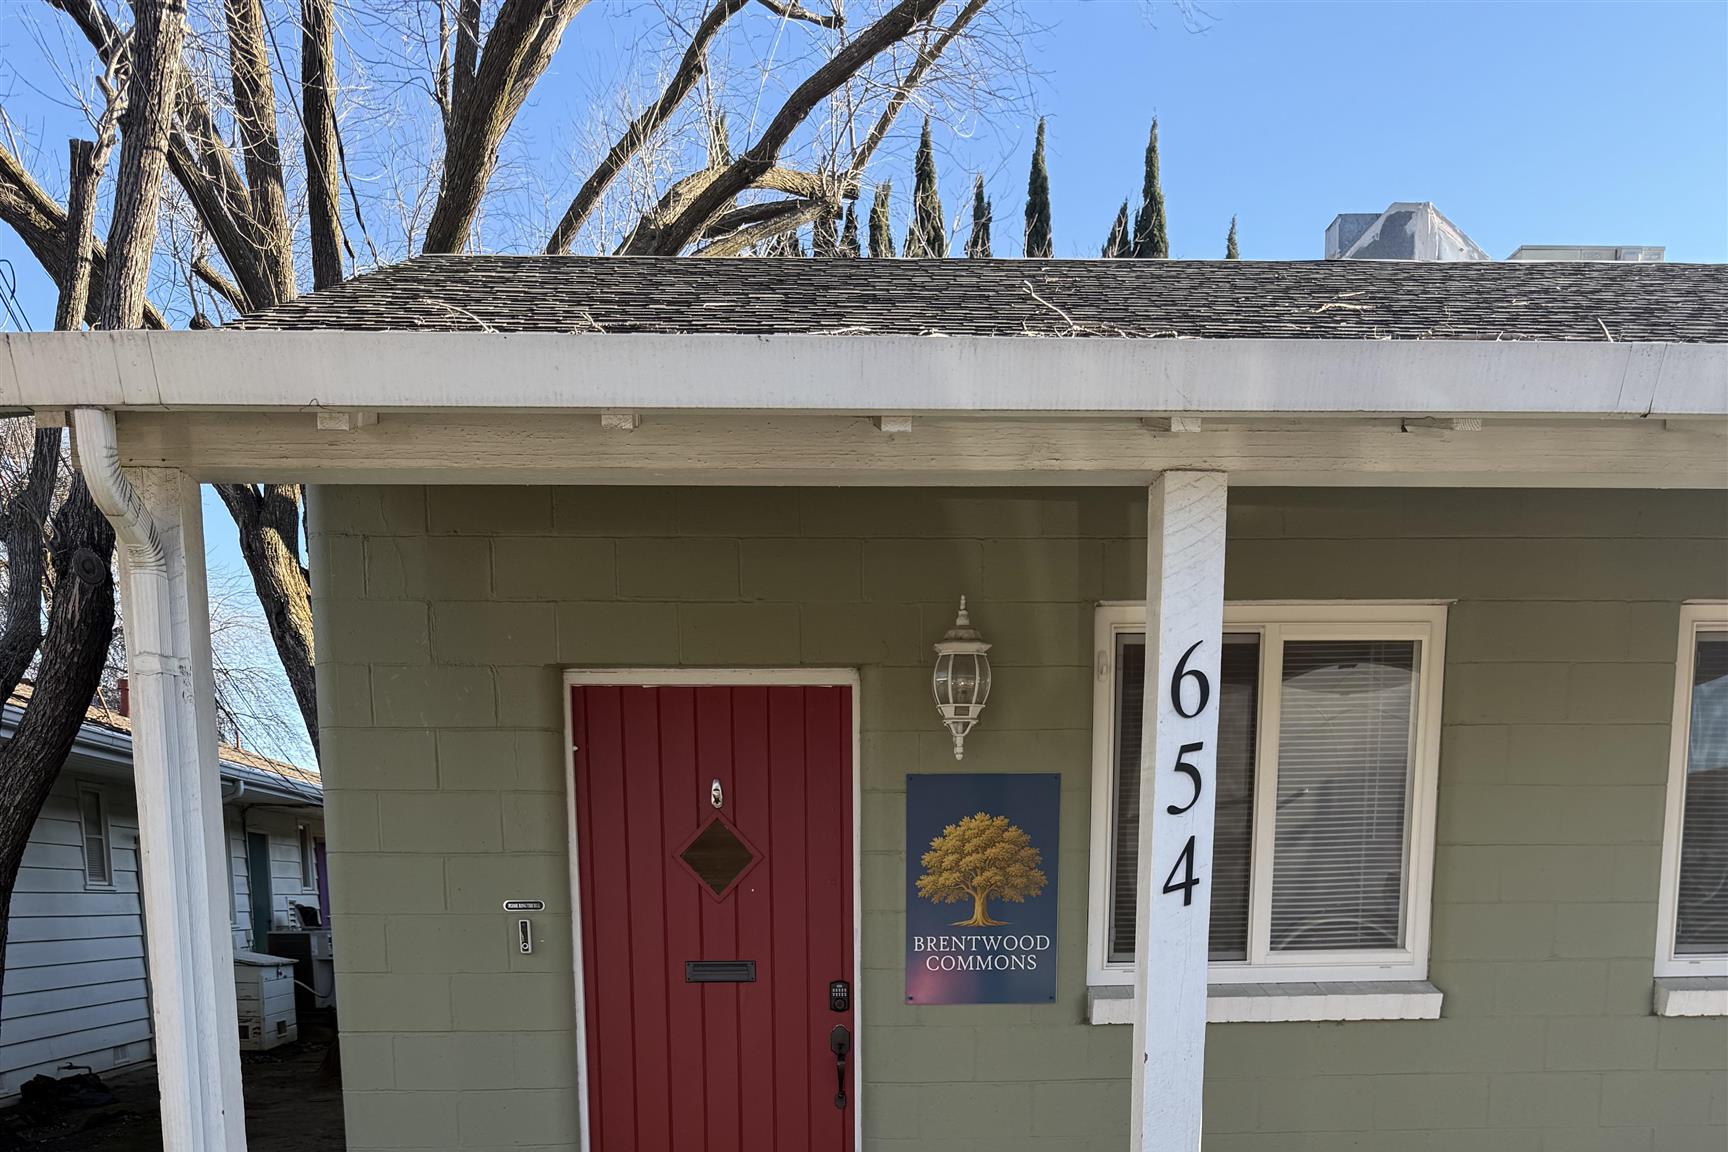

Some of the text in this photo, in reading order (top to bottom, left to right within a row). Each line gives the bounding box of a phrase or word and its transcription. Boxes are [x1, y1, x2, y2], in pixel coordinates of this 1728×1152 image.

[1163, 640, 1210, 906] 654
[913, 935, 1050, 952] BRENTWOOD
[926, 954, 1037, 971] COMMONS
